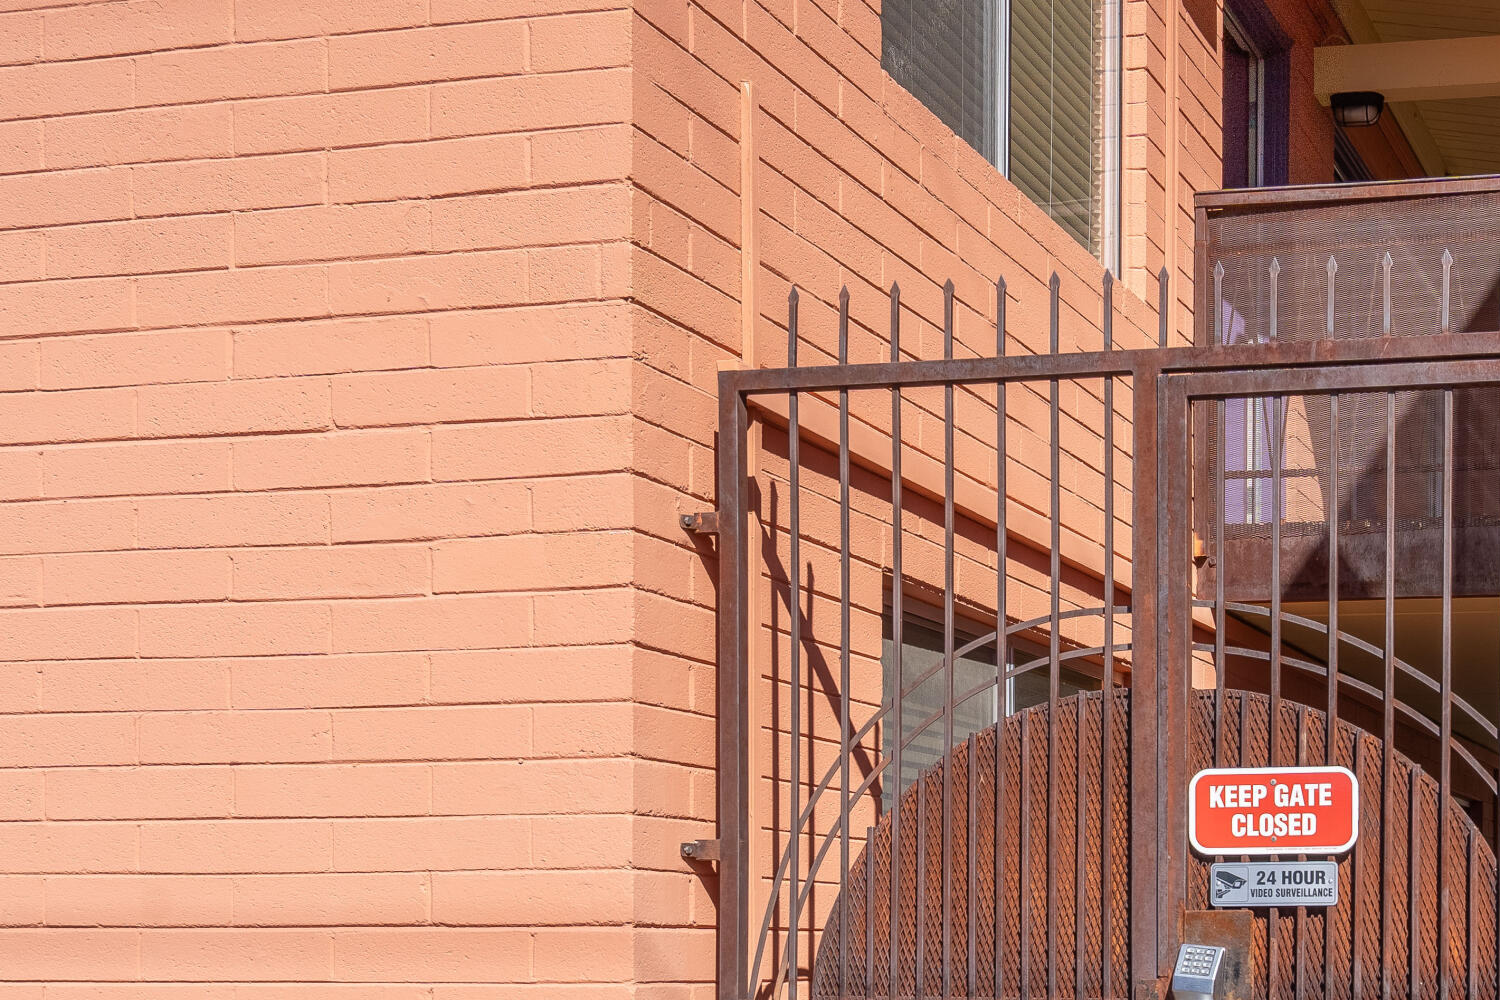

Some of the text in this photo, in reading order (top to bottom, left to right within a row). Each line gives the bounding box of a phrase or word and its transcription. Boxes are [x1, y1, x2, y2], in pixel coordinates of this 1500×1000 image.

[1209, 783, 1332, 808] KEEP GATE
[1231, 813, 1316, 837] CLOSED
[1256, 871, 1325, 885] 24 HOUR
[1250, 888, 1333, 897] VIDEO SURVEILLANCE
